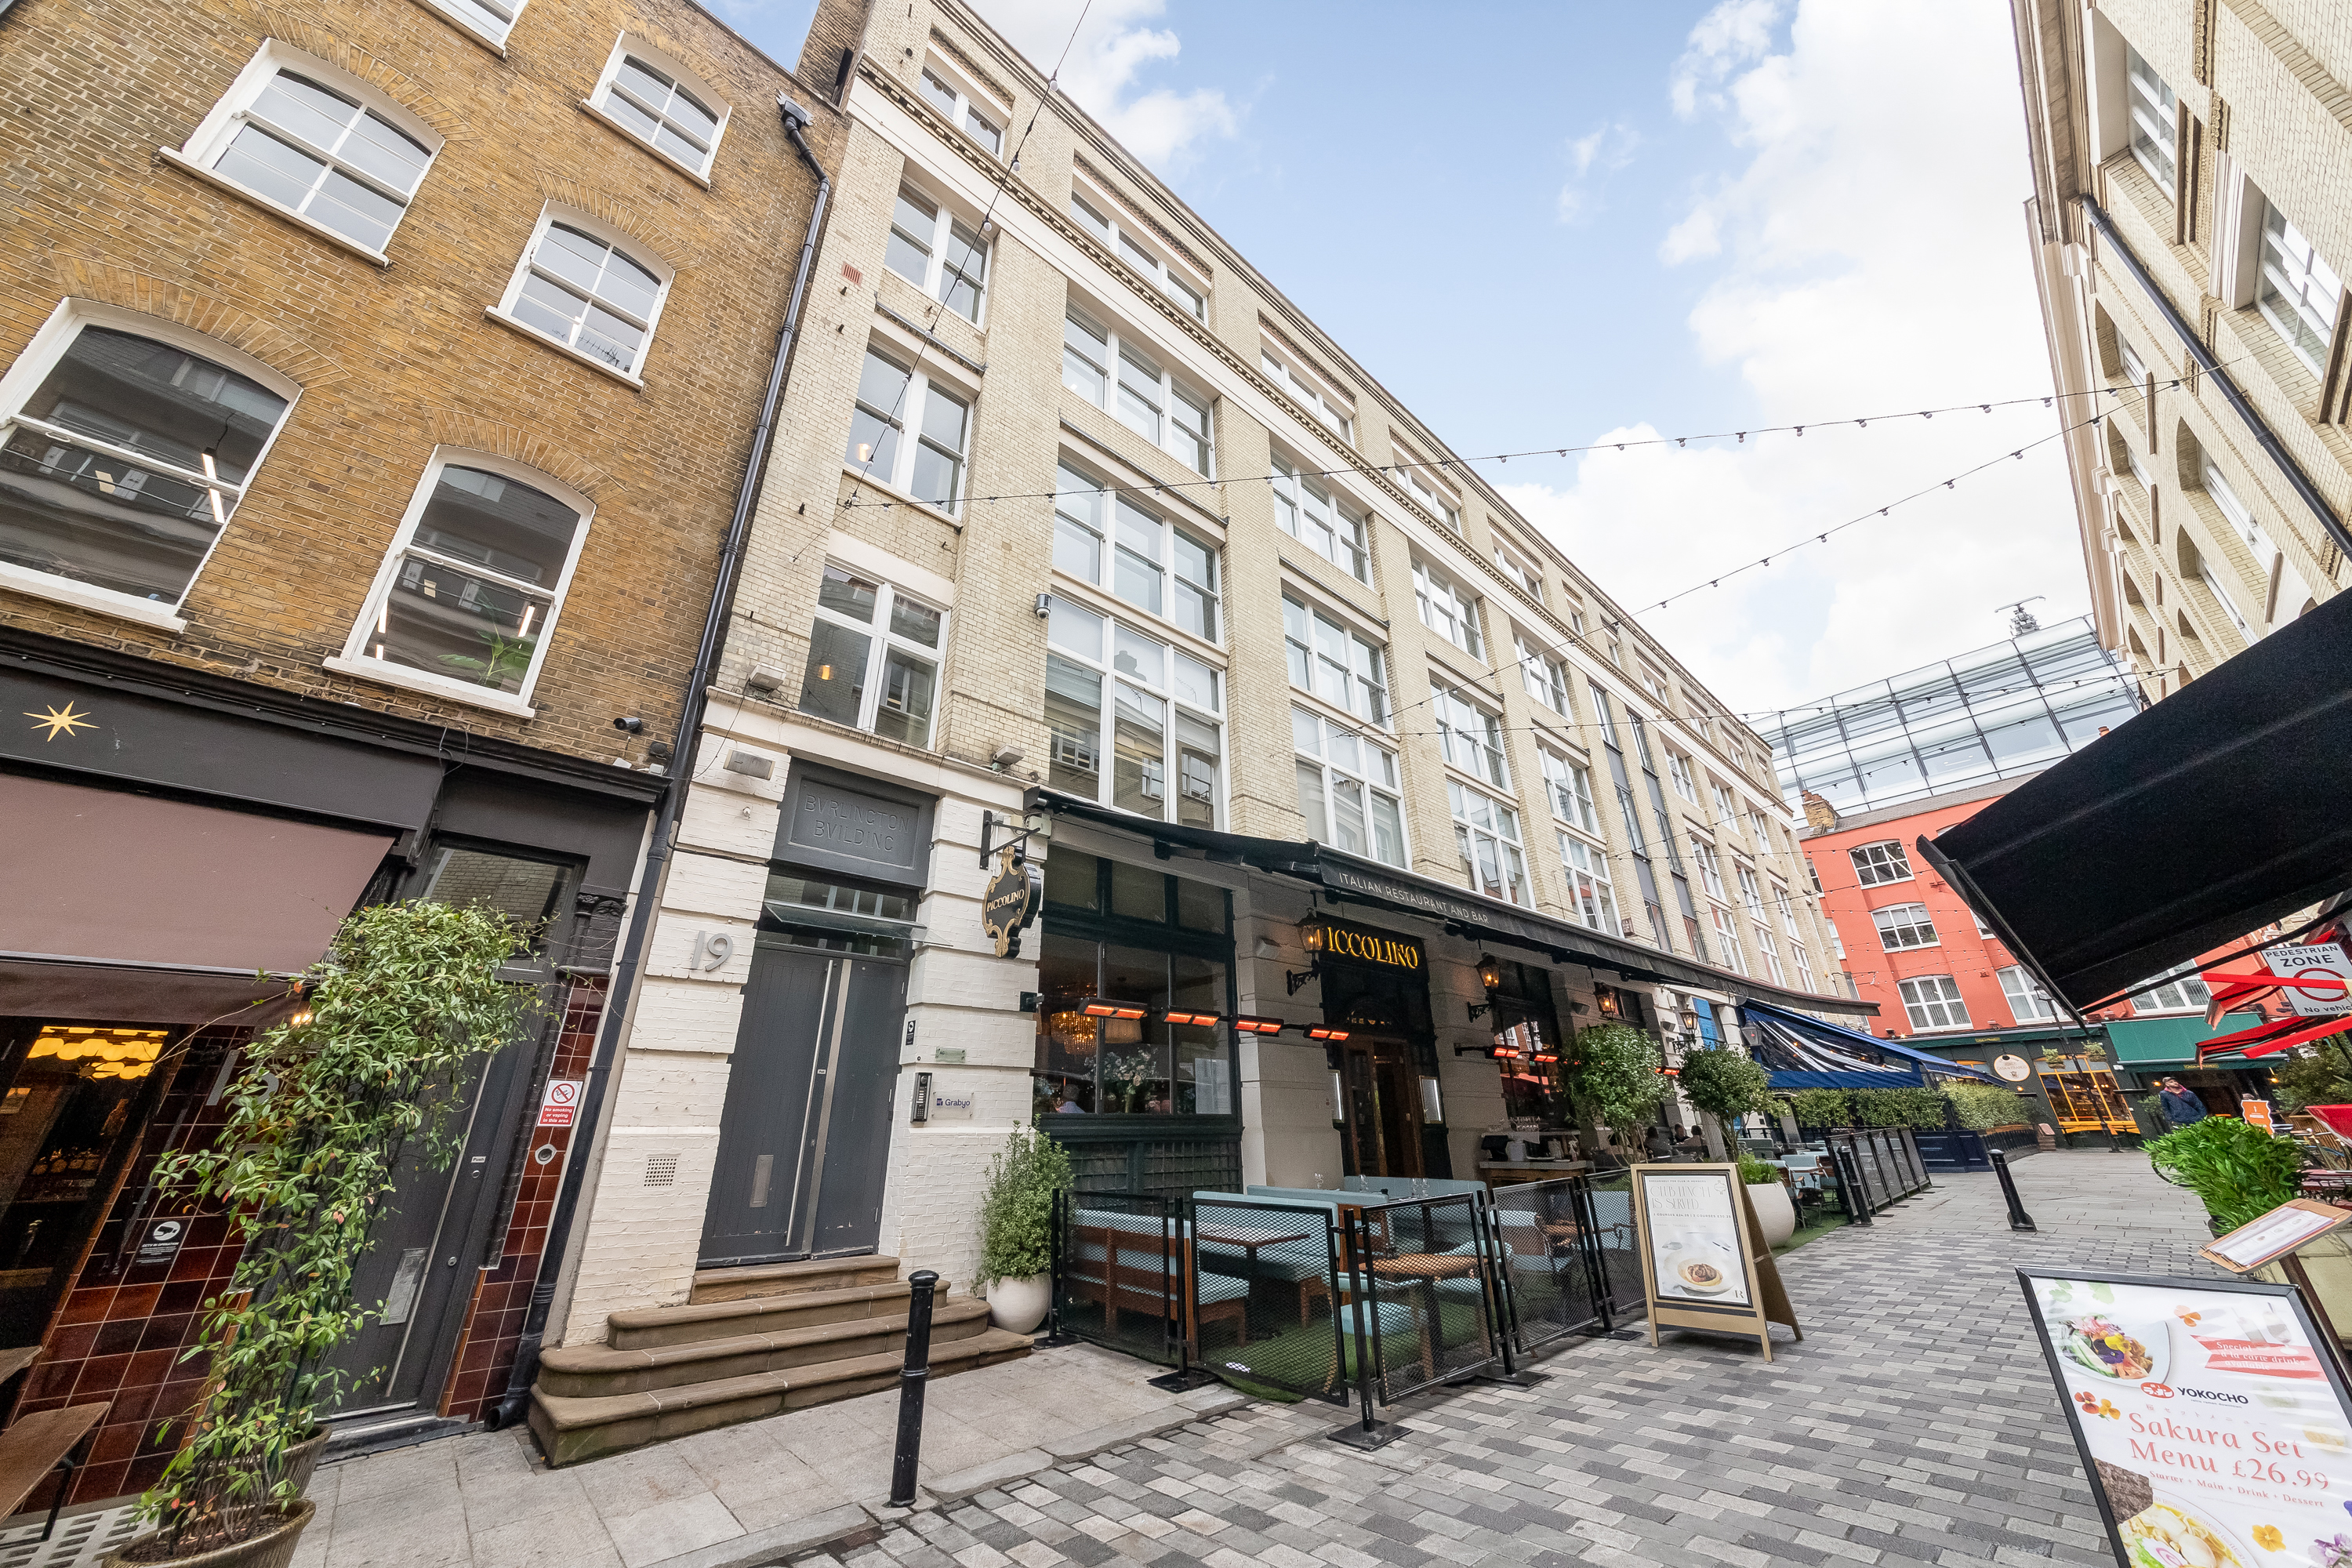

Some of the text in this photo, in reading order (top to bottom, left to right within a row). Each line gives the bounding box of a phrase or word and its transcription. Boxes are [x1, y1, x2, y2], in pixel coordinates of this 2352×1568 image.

[986, 888, 1025, 913] PICCOLINO
[1338, 872, 1490, 924] ITALIAN RESTAURANT AND BAR
[690, 930, 734, 971] 19
[2266, 945, 2339, 957] PEDESTRIAN
[2280, 954, 2335, 967] ZONE
[945, 1098, 971, 1109] Grabyo
[1650, 1185, 1711, 1198] CLUB LUNCH
[1651, 1198, 1663, 1209] IS
[2216, 1341, 2252, 1352] Special
[2225, 1359, 2270, 1370] available
[2271, 1356, 2305, 1367] drinks
[2176, 1386, 2249, 1404] YOKOCHO
[2128, 1411, 2305, 1459] Sakura Set
[2127, 1437, 2329, 1490] Menu £26.99
[2149, 1470, 2184, 1484] Starter
[2197, 1479, 2224, 1490] Main
[2238, 1486, 2269, 1499] Drink
[2282, 1494, 2325, 1508] Dessert
